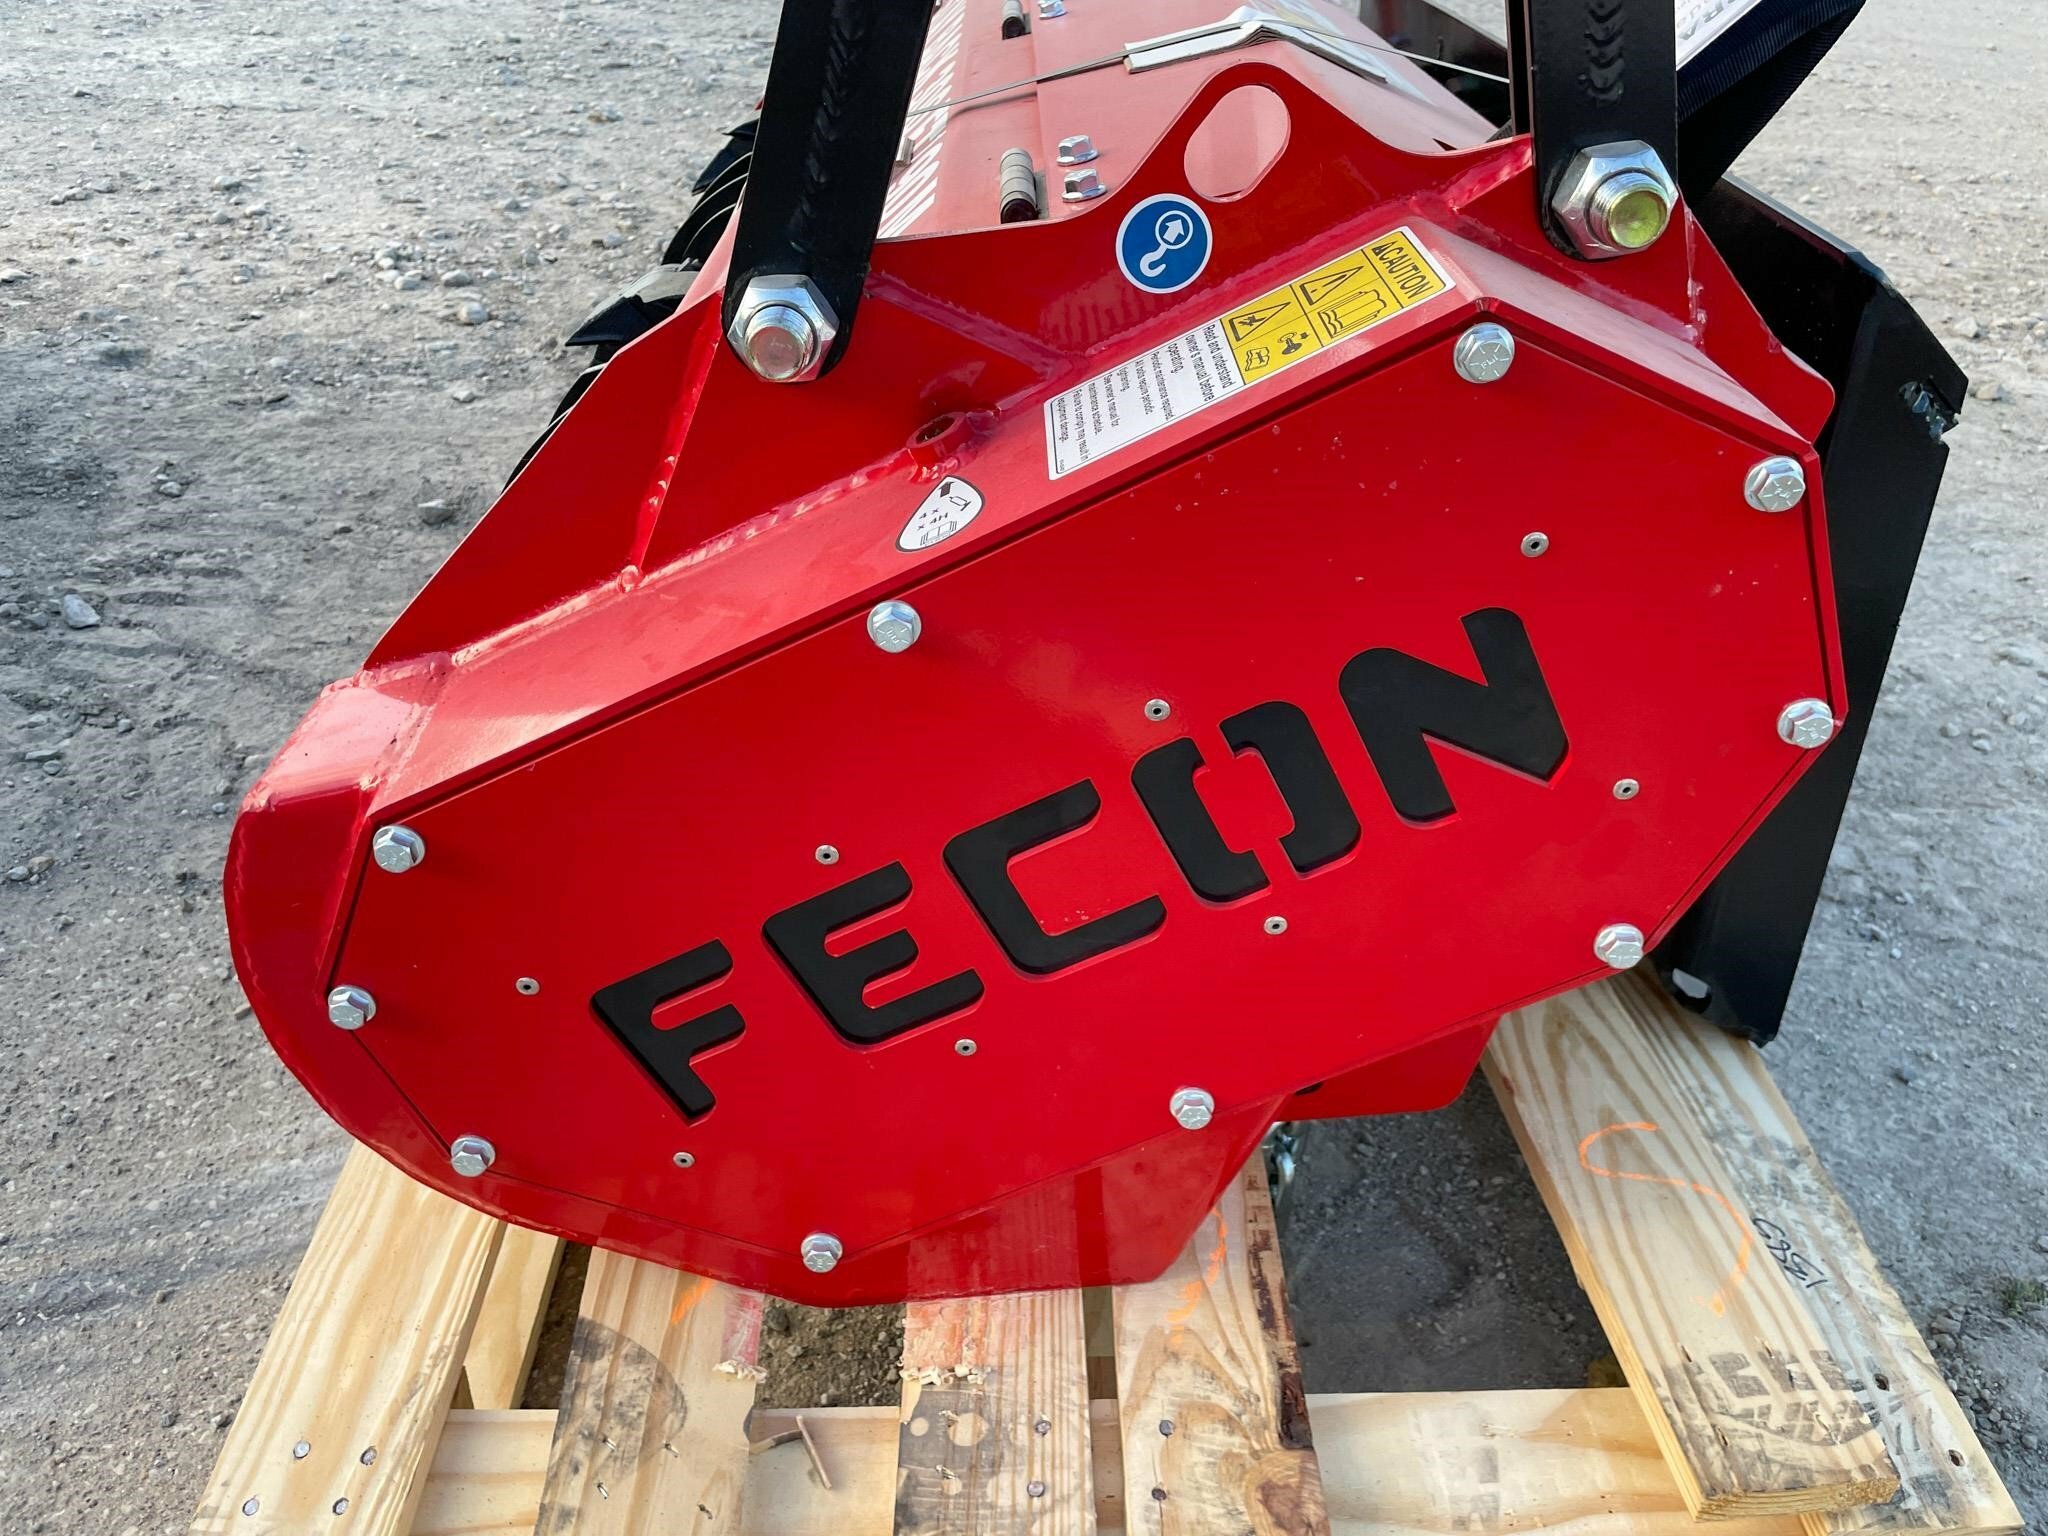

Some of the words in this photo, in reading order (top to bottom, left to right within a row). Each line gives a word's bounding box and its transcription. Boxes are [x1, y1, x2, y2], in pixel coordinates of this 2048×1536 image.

[1379, 245, 1433, 298] CAUTION
[1184, 333, 1201, 359] owner's
[1201, 323, 1219, 343] Read
[1207, 338, 1223, 354] and
[1149, 350, 1163, 371] Periodic
[1163, 341, 1186, 376] operating.
[1191, 354, 1210, 381] manual
[1211, 350, 1236, 389] understand
[1087, 381, 1100, 412] maintenance
[1104, 382, 1116, 403] owner's
[1153, 368, 1170, 400] maintenance
[1198, 376, 1218, 402] before
[1074, 404, 1082, 412] to
[1107, 400, 1118, 420] manual
[592, 606, 1570, 1120] FECON
